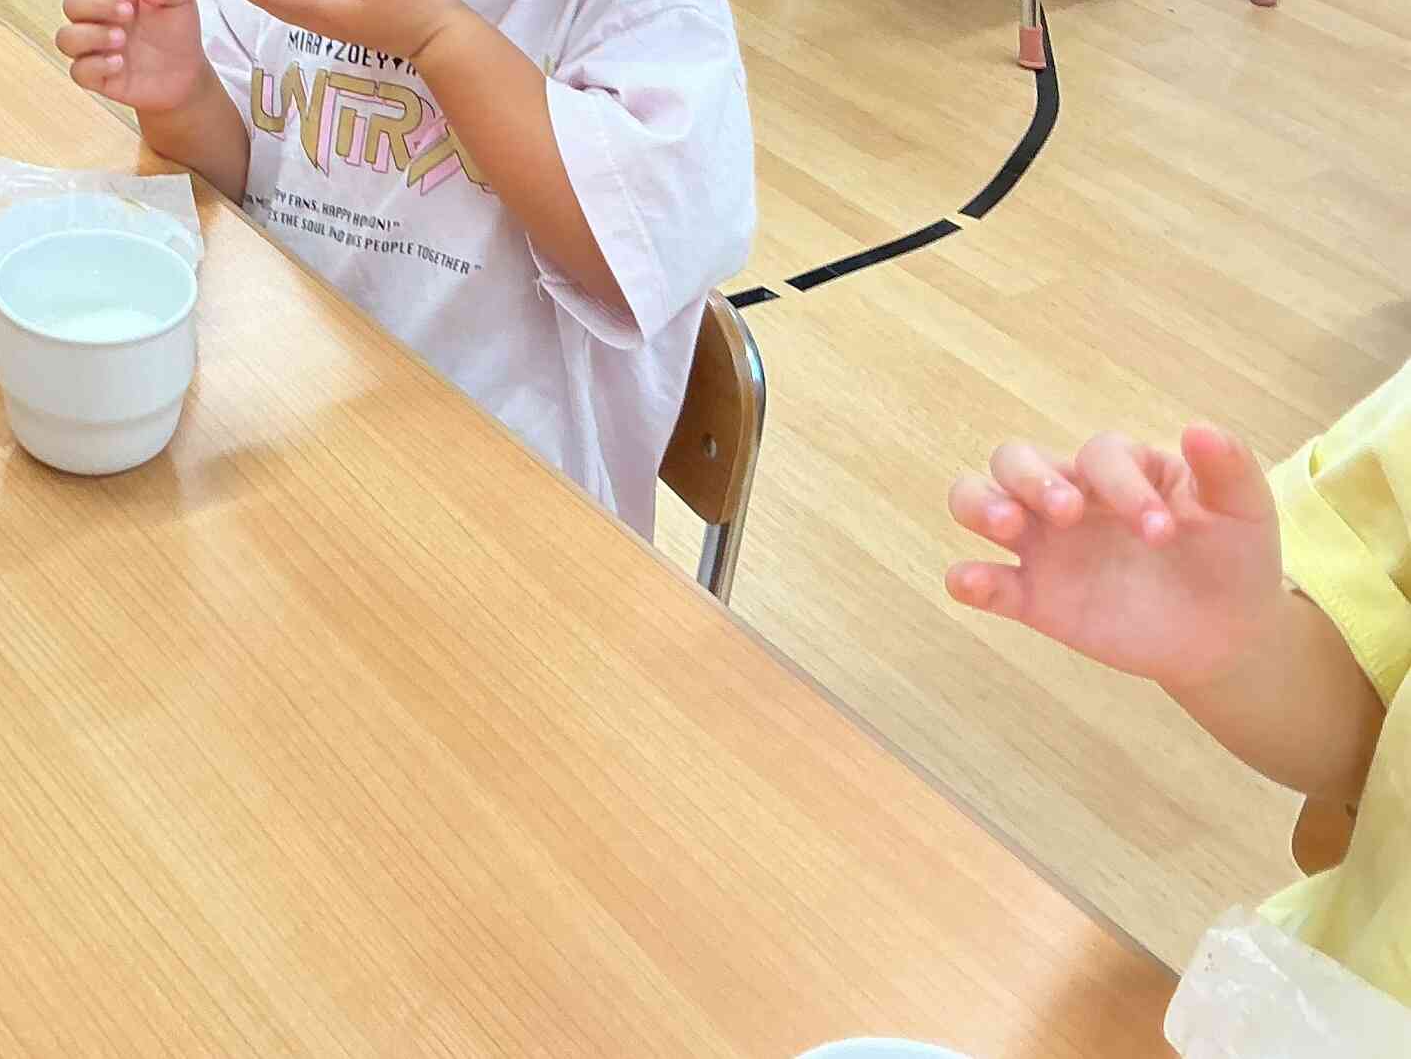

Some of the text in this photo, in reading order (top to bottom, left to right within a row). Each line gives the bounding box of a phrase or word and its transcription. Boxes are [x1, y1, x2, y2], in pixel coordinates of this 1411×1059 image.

[334, 39, 390, 69] ZOEY
[281, 212, 298, 228] THE
[301, 218, 325, 236] SOUL
[364, 238, 414, 256] PEOPLE
[417, 244, 470, 275] TOGETHER
